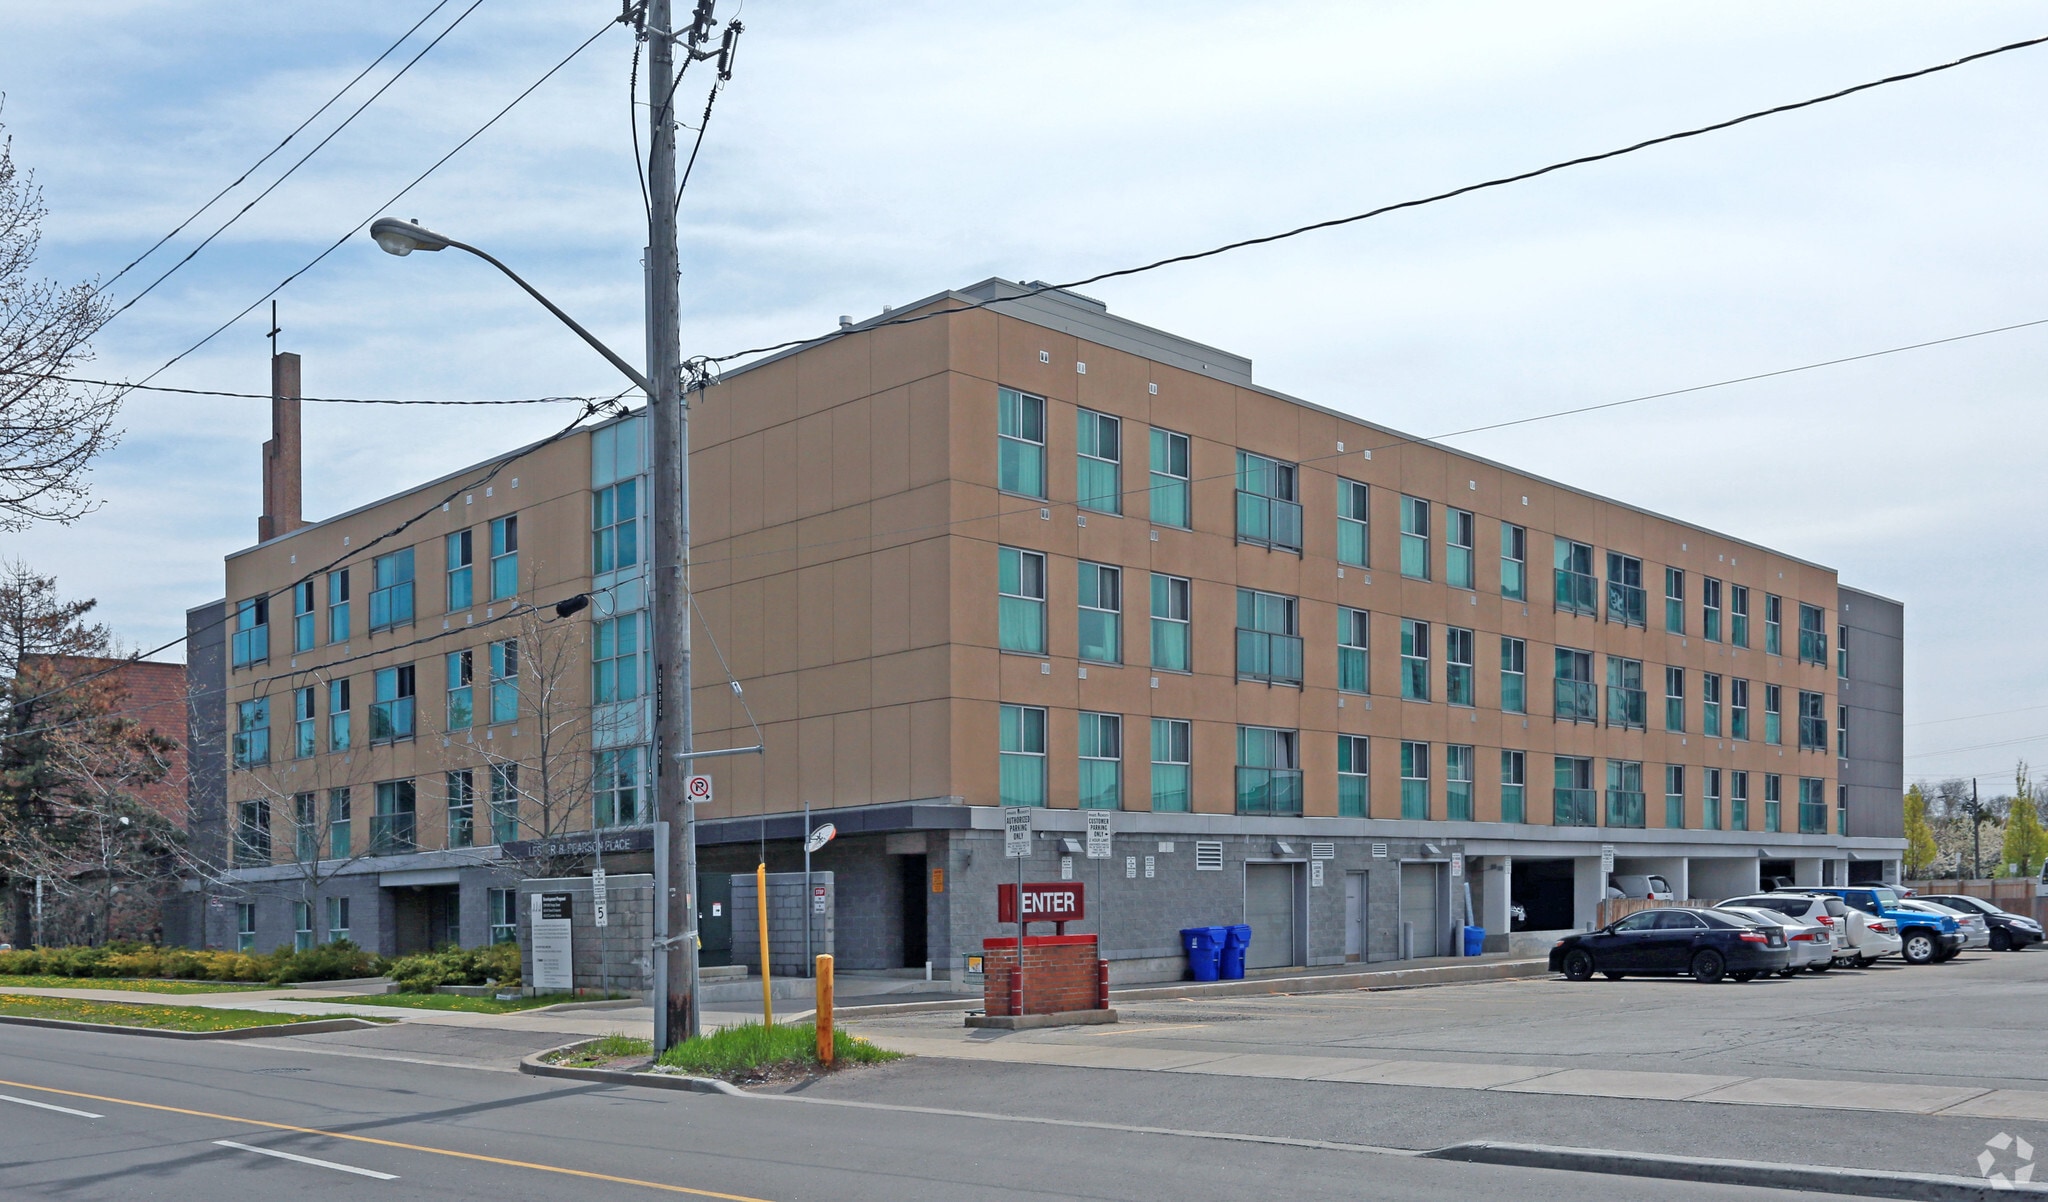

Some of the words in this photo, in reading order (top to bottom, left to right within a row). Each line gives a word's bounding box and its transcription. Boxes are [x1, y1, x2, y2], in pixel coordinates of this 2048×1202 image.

[1007, 815, 1030, 825] AUTHORIZED
[1010, 823, 1028, 832] PARKING
[1013, 832, 1024, 840] ONLY
[604, 838, 631, 851] PLACE
[1022, 892, 1075, 912] ENTER
[598, 906, 604, 919] 5
